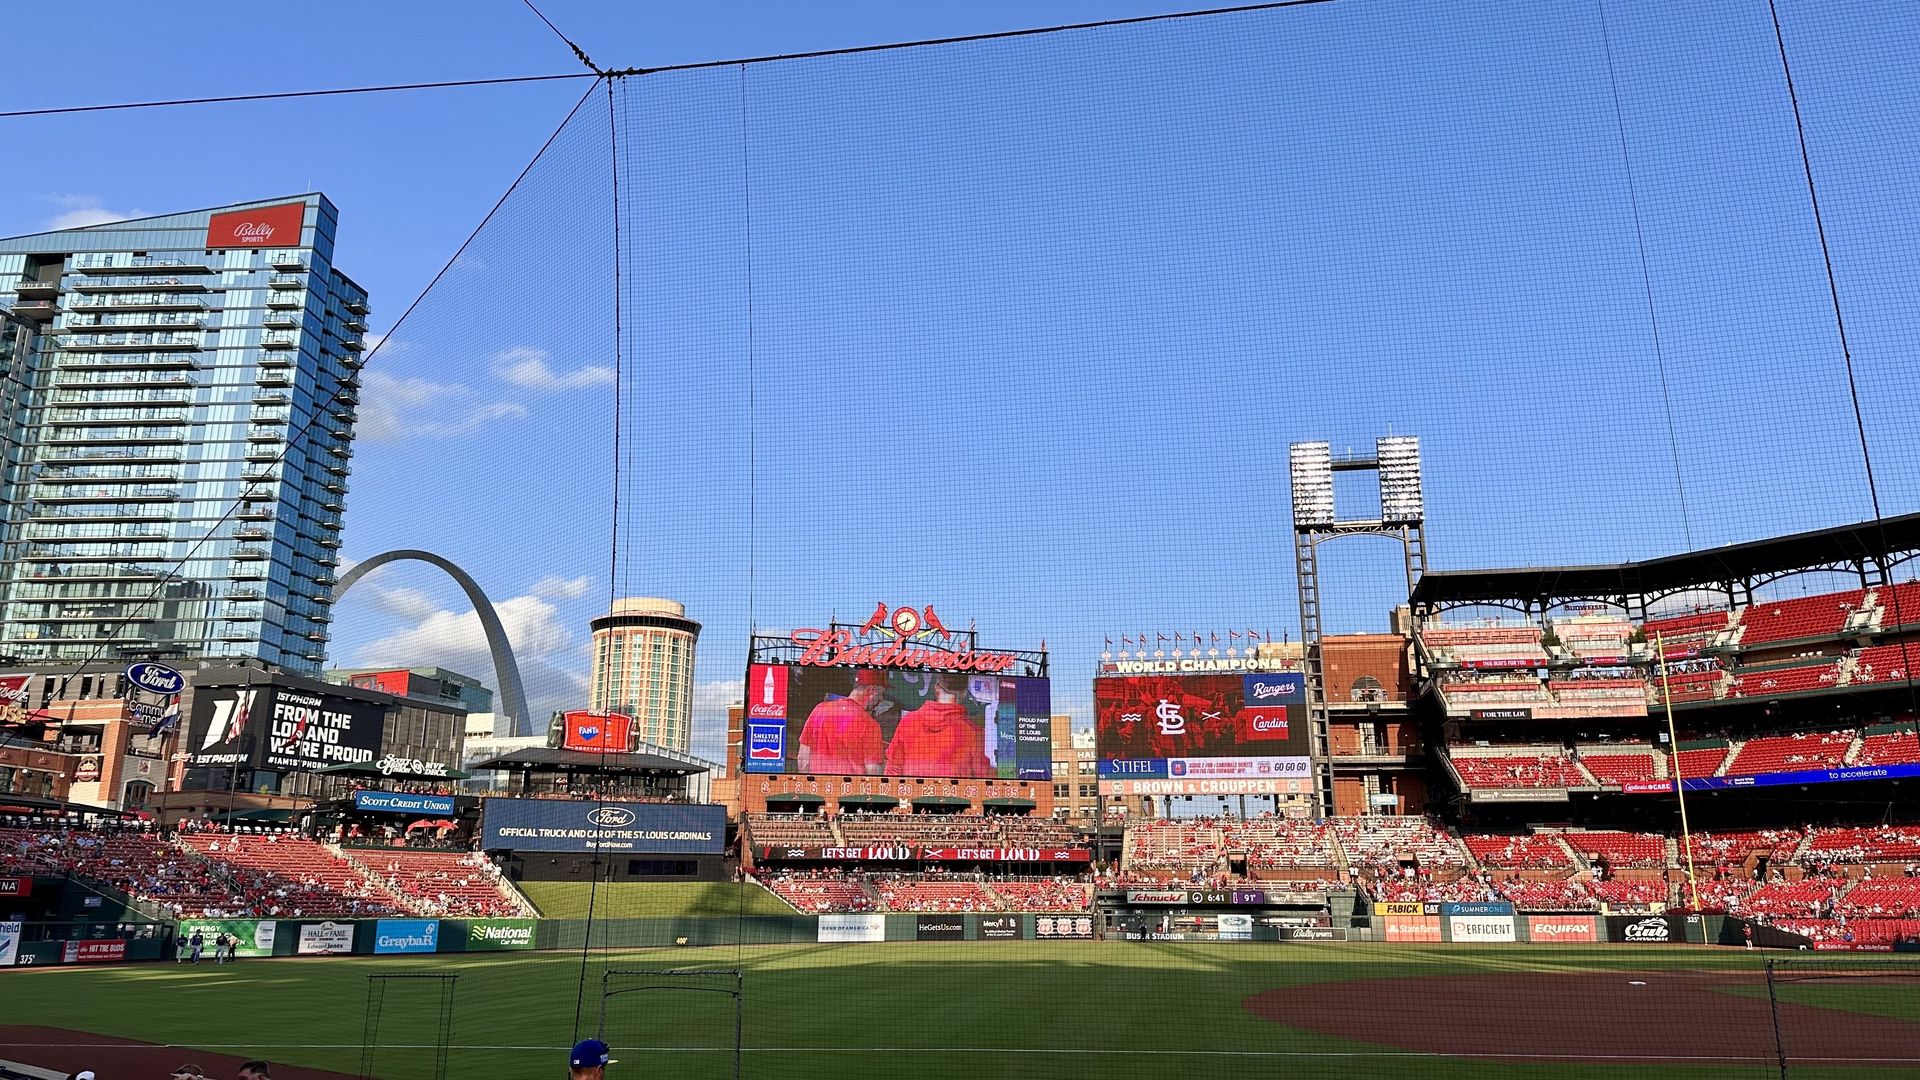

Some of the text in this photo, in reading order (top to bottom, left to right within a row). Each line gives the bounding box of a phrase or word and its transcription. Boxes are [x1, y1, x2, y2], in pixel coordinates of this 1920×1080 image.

[234, 222, 275, 239] Bally
[791, 628, 1017, 671] Budweiser
[1116, 658, 1281, 673] WORLD CHAMPIONS
[140, 666, 177, 689] Ford
[1253, 682, 1295, 699] Rangers
[274, 703, 352, 730] FROM THE
[305, 726, 339, 744] AND
[579, 726, 600, 735] FANTA
[1000, 731, 1017, 743] Mercy
[270, 736, 373, 763] WE'RE PROUD
[1112, 759, 1155, 773] STIFEL
[1275, 762, 1306, 771] GO GO GO
[424, 768, 448, 777] DECK
[1840, 769, 1887, 778] accelerate
[783, 781, 788, 793] 1
[795, 782, 804, 794] 2
[825, 782, 833, 794] 9
[841, 782, 852, 794] 10
[860, 782, 872, 795] 14
[879, 783, 891, 795] 17
[898, 784, 913, 796] 20
[922, 784, 936, 796] 23
[943, 785, 957, 796] 24
[964, 785, 979, 797] 42
[986, 786, 1000, 798] 45
[1005, 786, 1019, 798] 85
[1134, 781, 1184, 793] BROWN
[1187, 782, 1197, 792] &
[1200, 780, 1275, 793] CROUPPEN
[360, 796, 451, 810] SCOTT CREDIT UNION
[596, 809, 627, 824] Ford
[499, 828, 711, 840] OFFICIAL TRUCK AND CAR OF THE ST. LOUIS CARDINALS
[822, 847, 1040, 860] LET'S GET LOUD LET'S GET LOUD
[1131, 893, 1184, 902] Schnucks
[1208, 894, 1224, 902] 6:41
[1244, 894, 1256, 902] 91°
[1271, 895, 1287, 903] Mercy
[1387, 904, 1439, 914] FABICK CAT
[0, 923, 20, 933] hield
[983, 920, 999, 928] Mercy
[1535, 923, 1589, 936] EQUIFAX
[1625, 923, 1668, 937] Club
[485, 926, 532, 939] National
[1152, 932, 1184, 940] STADIUM
[1293, 929, 1316, 939] Bally
[99, 944, 109, 952] THE
[20, 955, 35, 964] 375'
